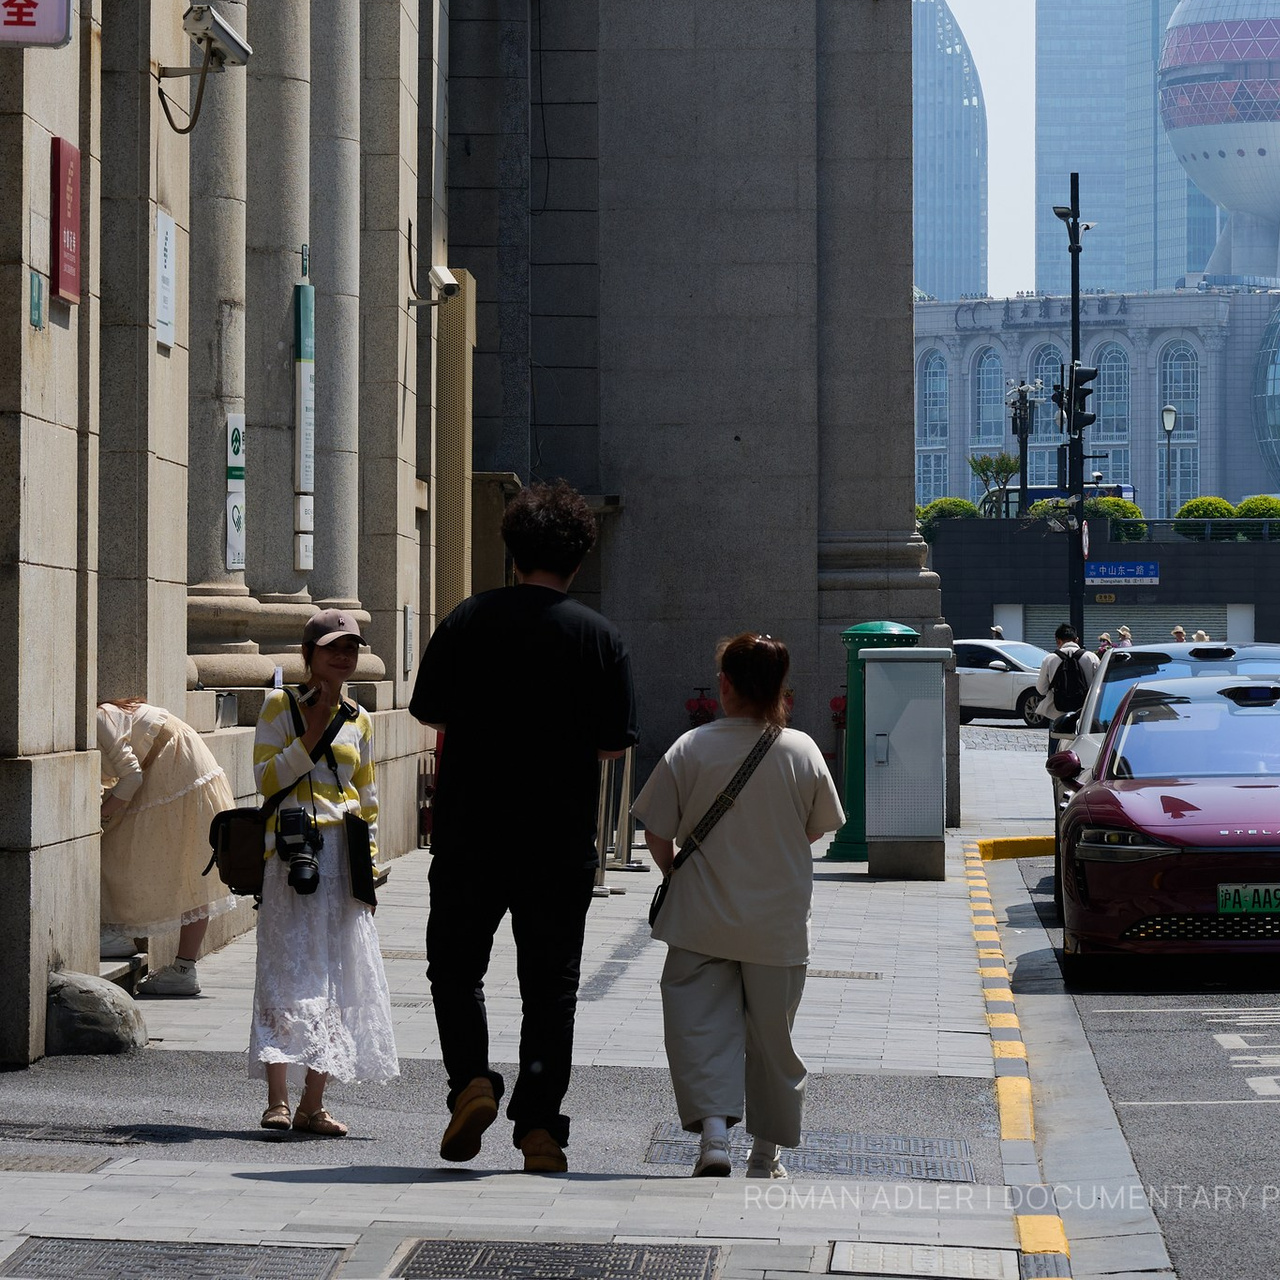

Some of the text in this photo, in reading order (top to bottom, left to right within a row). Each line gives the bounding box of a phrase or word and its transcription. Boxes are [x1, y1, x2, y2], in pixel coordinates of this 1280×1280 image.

[1099, 565, 1145, 576] 中山东一路
